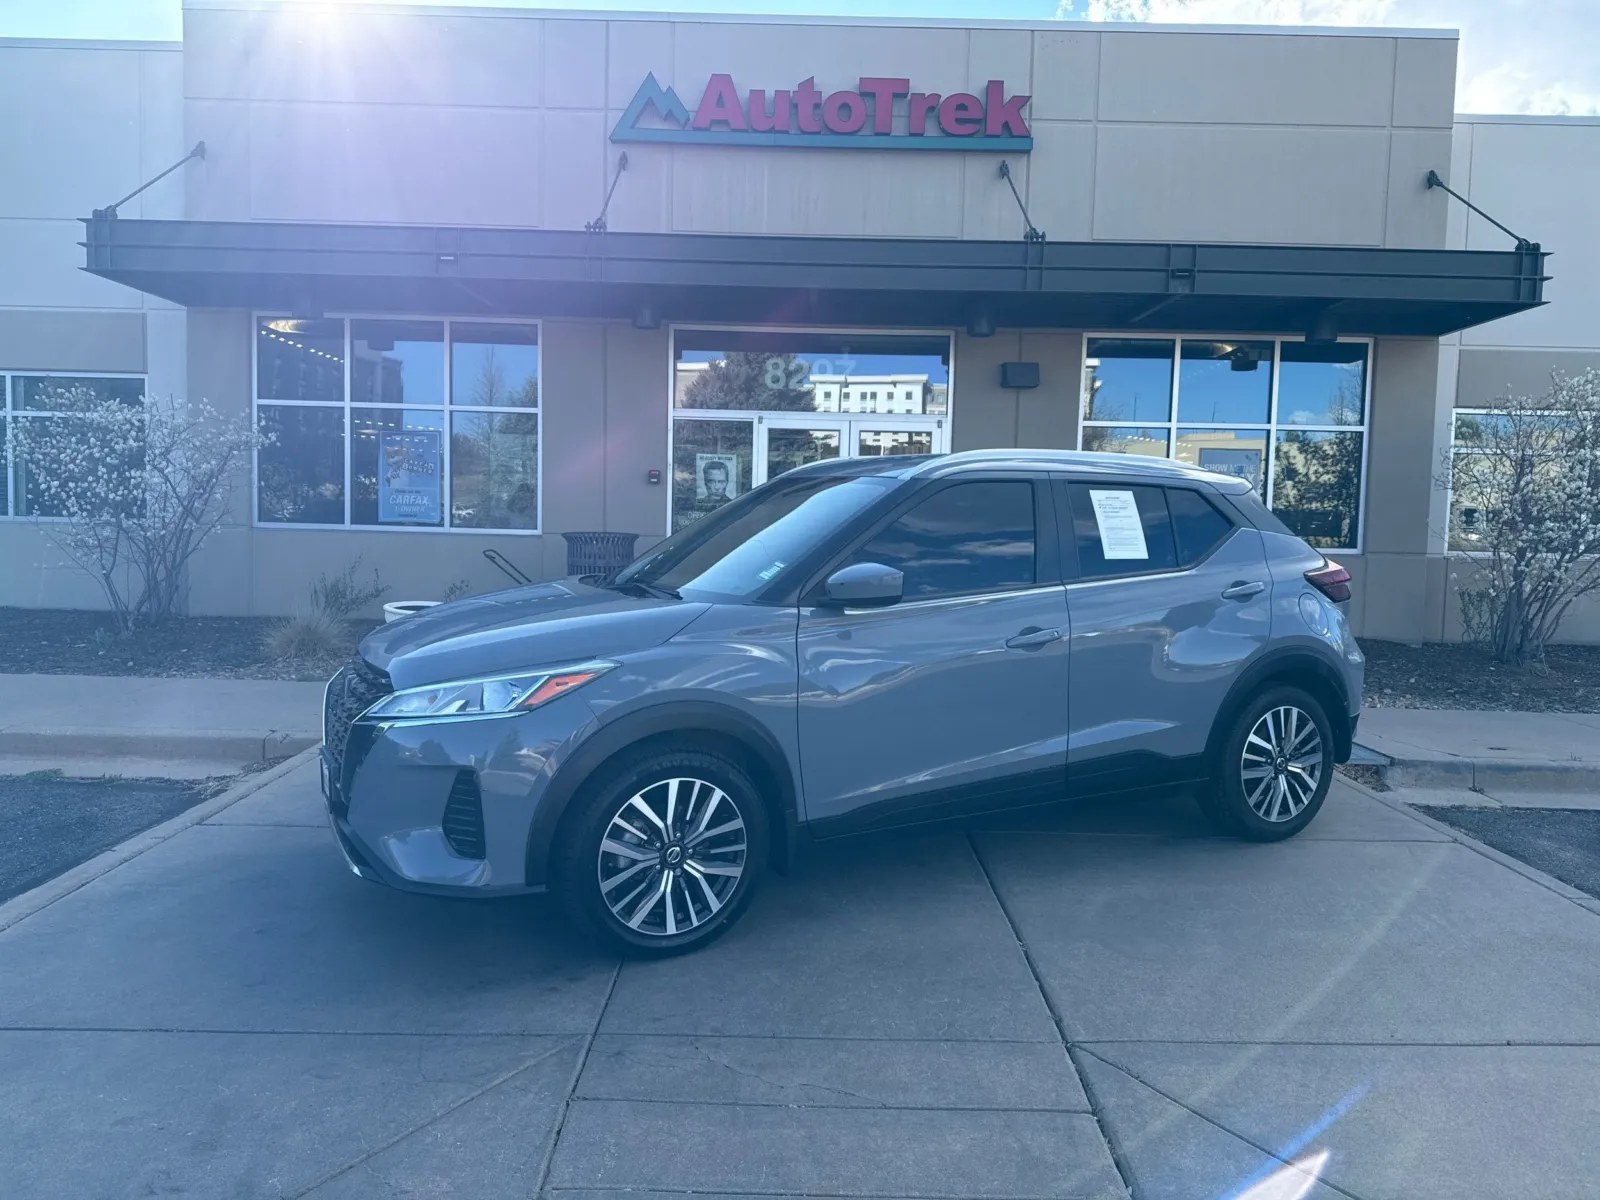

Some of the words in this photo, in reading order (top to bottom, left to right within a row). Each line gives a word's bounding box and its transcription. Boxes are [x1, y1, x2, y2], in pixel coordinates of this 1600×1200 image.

[691, 73, 1032, 137] AutoTrek
[1204, 463, 1228, 472] SHOW
[389, 494, 429, 505] CARFAX
